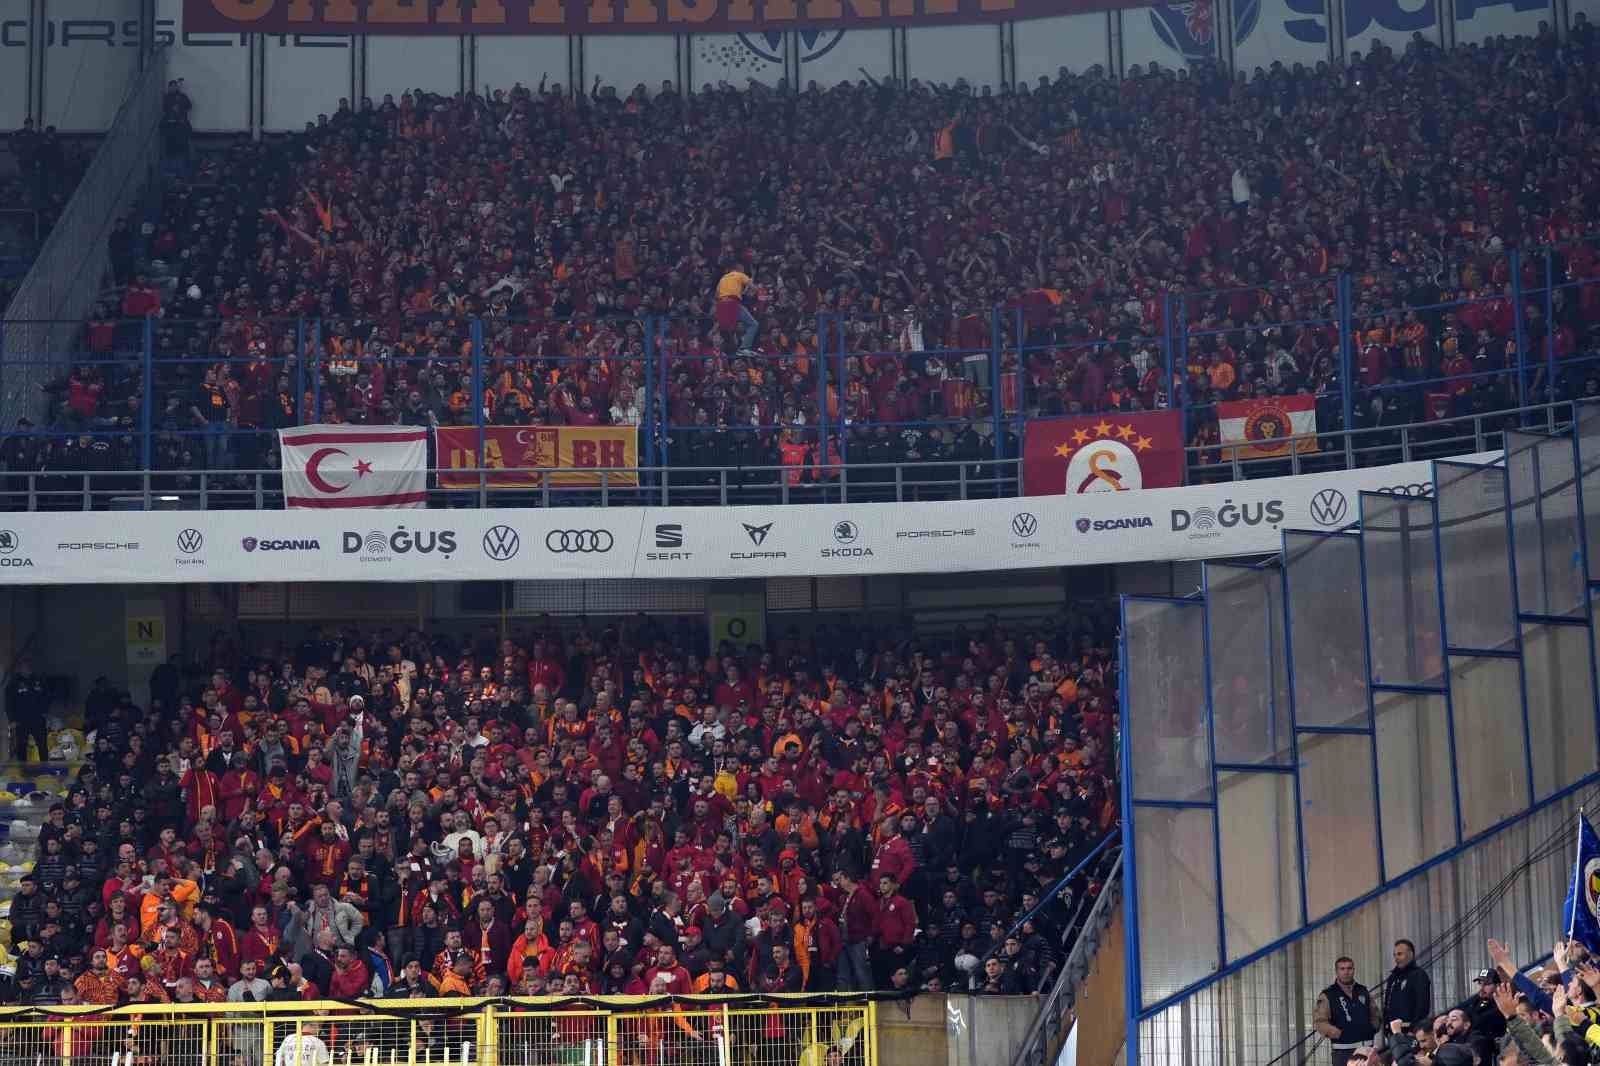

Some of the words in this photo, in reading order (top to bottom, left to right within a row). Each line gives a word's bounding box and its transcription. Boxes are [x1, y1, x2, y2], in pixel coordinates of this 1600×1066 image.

[572, 439, 626, 468] BH
[1093, 517, 1153, 531] SCANIA
[896, 528, 977, 539] PORSCHE
[57, 543, 140, 551] PORSCHE
[260, 539, 320, 551] SCANIA
[646, 552, 693, 561] SEAT
[730, 551, 787, 559] CUPRA
[137, 621, 153, 639] N
